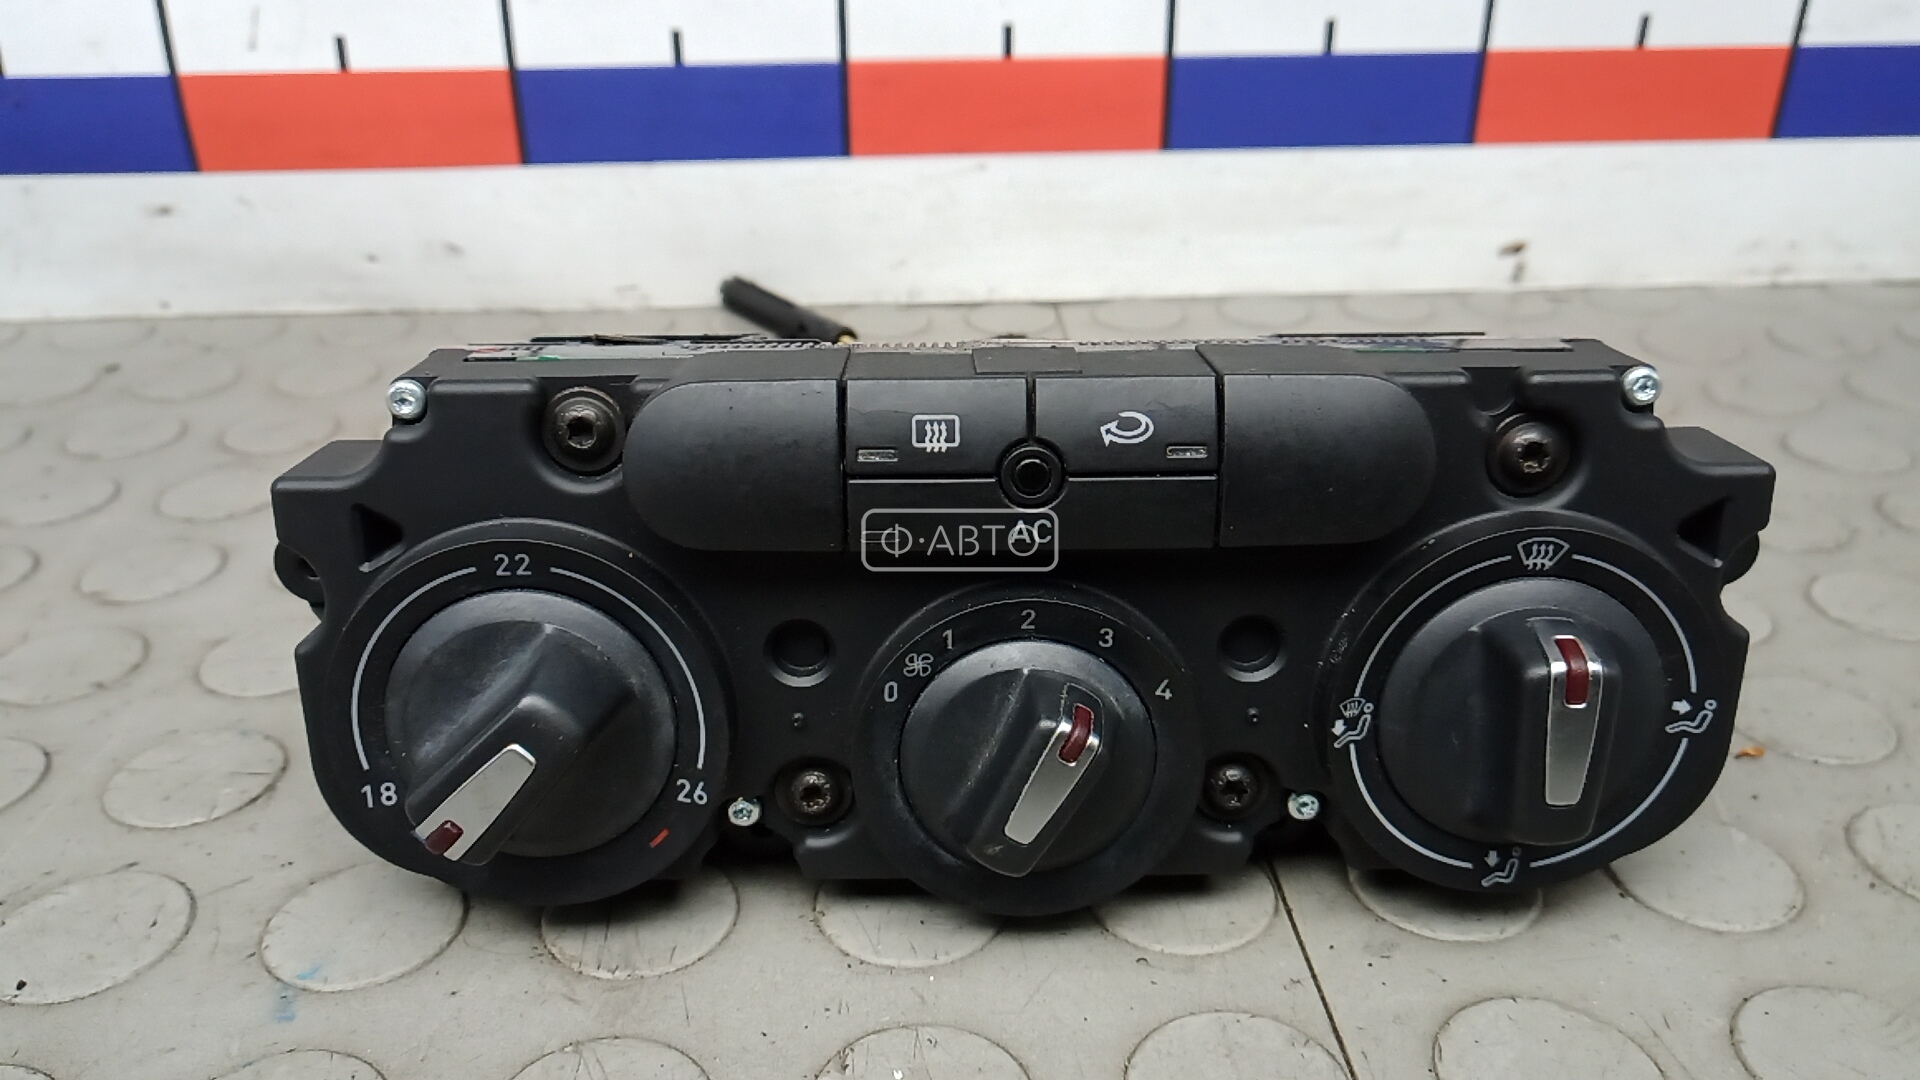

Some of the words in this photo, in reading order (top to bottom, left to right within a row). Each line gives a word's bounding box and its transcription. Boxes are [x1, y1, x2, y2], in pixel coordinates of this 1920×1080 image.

[494, 553, 532, 576] 22
[1020, 608, 1036, 630] 2
[942, 628, 954, 650] 1
[1098, 628, 1114, 648] 3
[883, 681, 898, 702] 0
[1154, 679, 1173, 700] 4
[361, 782, 398, 808] 18
[676, 778, 709, 806] 26
